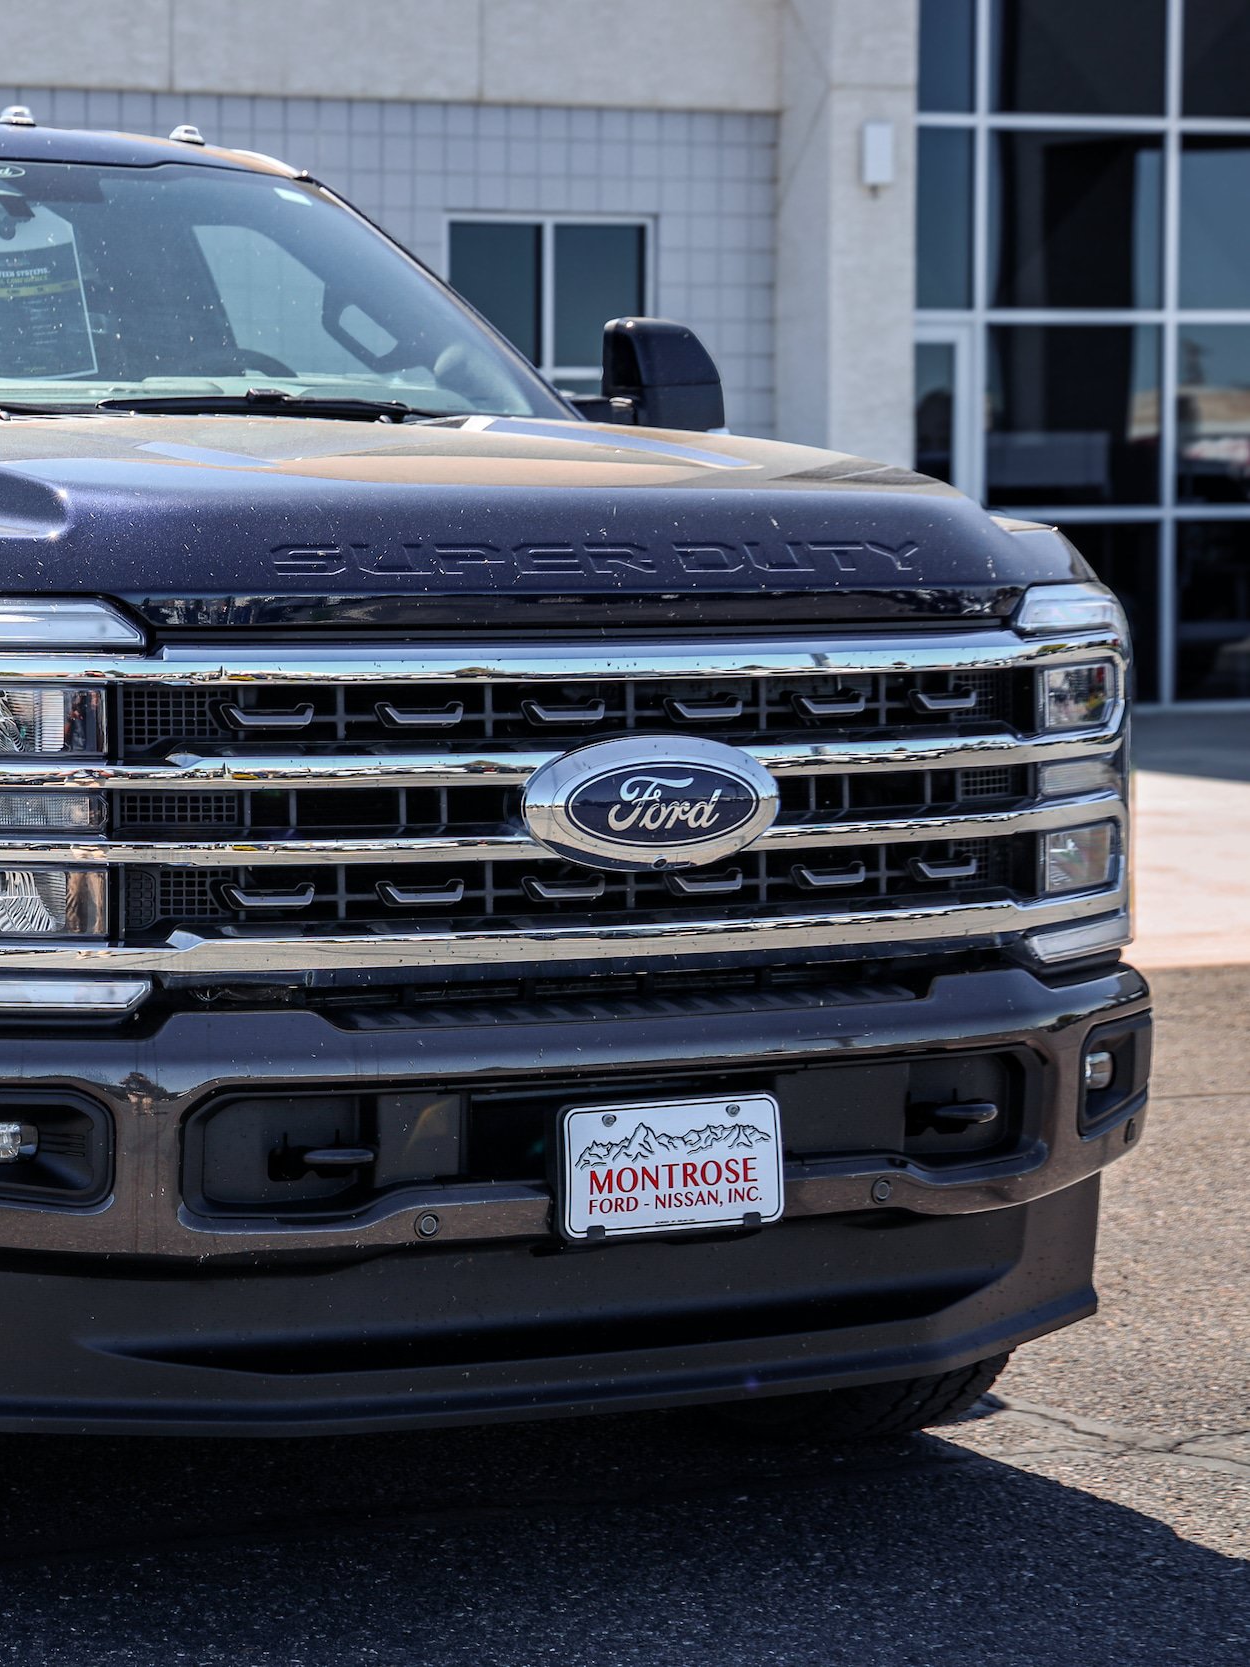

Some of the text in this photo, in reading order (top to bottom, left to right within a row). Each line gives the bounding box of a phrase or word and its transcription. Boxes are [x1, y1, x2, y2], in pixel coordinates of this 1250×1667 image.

[269, 541, 919, 576] SUPER DUTY
[607, 775, 723, 832] Ford
[589, 1157, 758, 1195] MONTROSE
[588, 1197, 638, 1215] FORD
[728, 1186, 763, 1202] INC.
